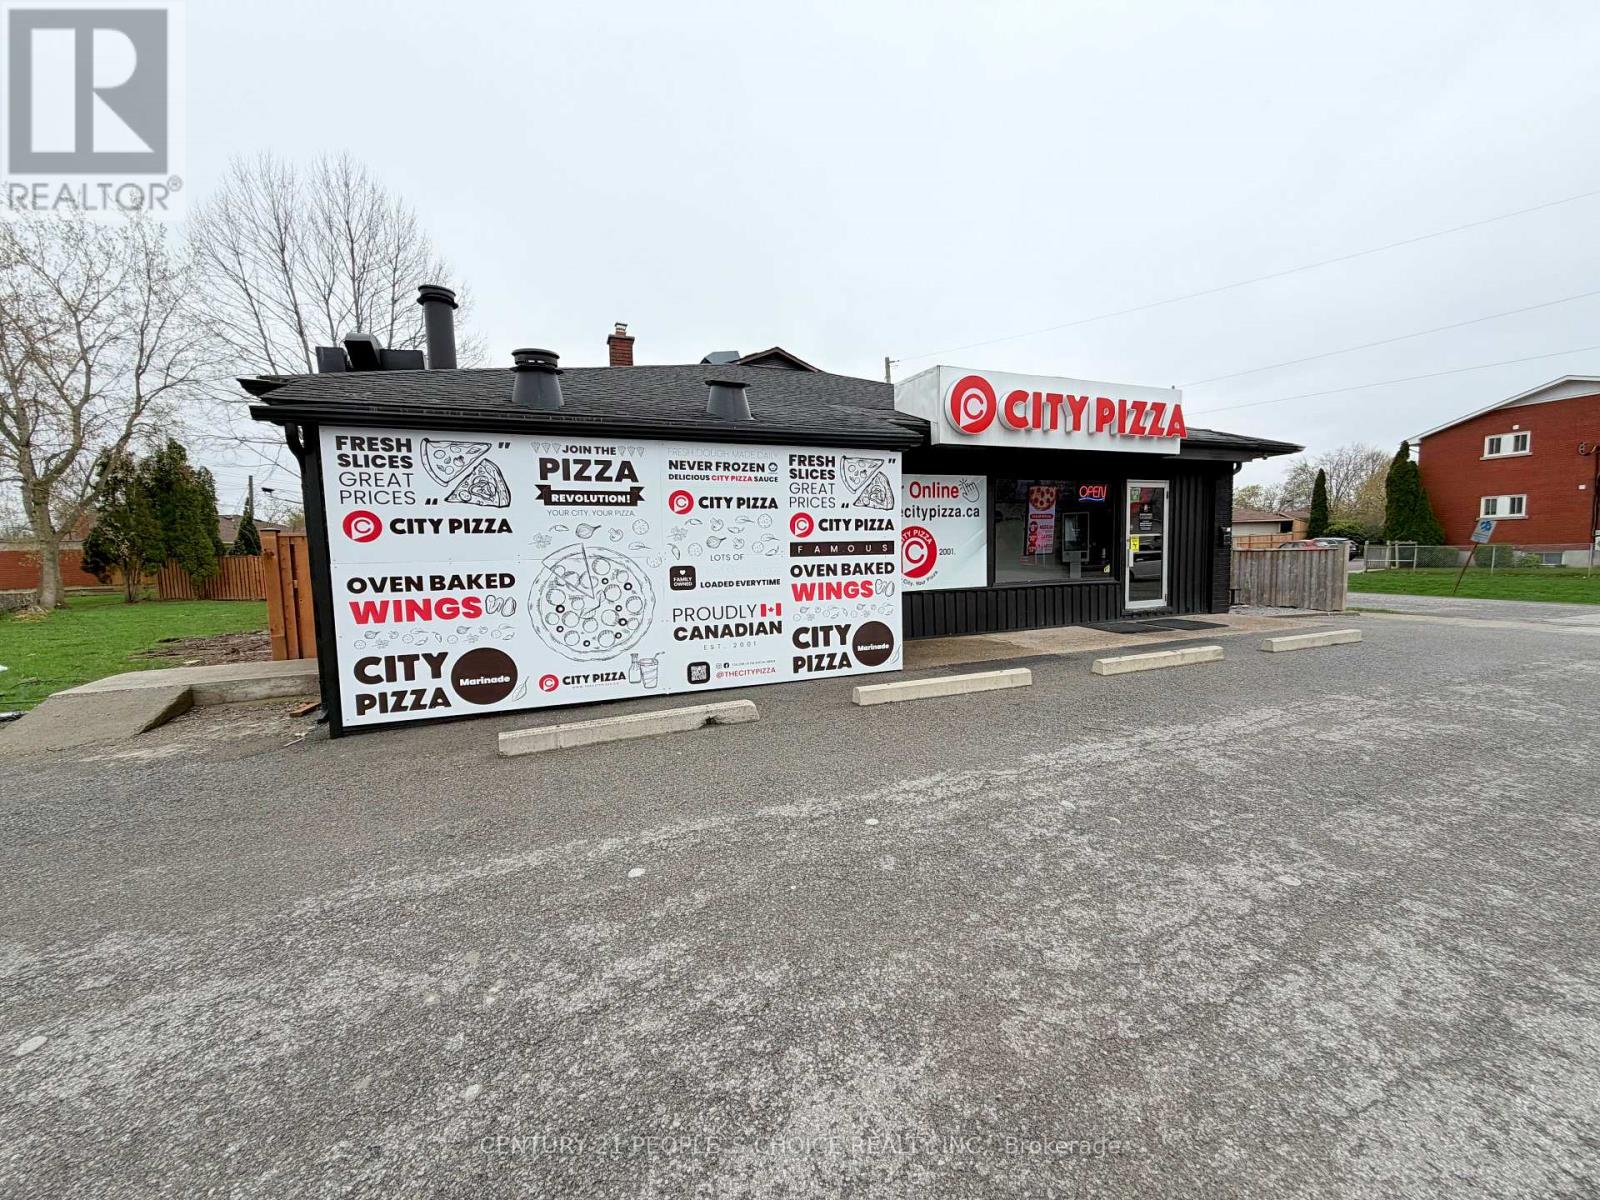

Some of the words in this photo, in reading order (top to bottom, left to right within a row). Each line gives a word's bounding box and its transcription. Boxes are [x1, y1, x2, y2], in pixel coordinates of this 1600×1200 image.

[1003, 389, 1089, 432] CITY
[1096, 397, 1188, 438] PIZZA
[335, 435, 412, 453] FRESH
[562, 445, 592, 454] JOIN
[593, 446, 617, 455] THE
[337, 453, 413, 469] SLICES
[668, 460, 713, 471] NEVER
[715, 462, 765, 473] FROZEN
[789, 454, 835, 467] FRESH
[539, 457, 639, 482] PIZZA
[789, 468, 835, 480] SLICES
[339, 471, 414, 488] GREAT
[789, 482, 836, 495] GREAT
[909, 481, 960, 499] Online
[1079, 485, 1107, 498] OPEN
[340, 490, 416, 505] PRICES
[551, 494, 631, 503] REVOLUTION!
[698, 496, 733, 509] CITY
[736, 497, 778, 509] PIZZA
[789, 497, 836, 508] PRICES
[546, 509, 569, 517] YOUR
[592, 509, 614, 517] YOUR
[901, 505, 980, 521] citypizza.ca
[389, 518, 443, 535] CITY
[450, 518, 513, 534] PIZZA
[818, 519, 852, 531] CITY
[855, 519, 894, 531] PIZZA
[913, 529, 933, 545] PIZZA
[797, 544, 888, 553] FAMOUS
[732, 553, 744, 561] OF
[790, 564, 838, 578] OVEN
[841, 562, 895, 576] BAKED
[346, 575, 424, 594] OVEN
[429, 573, 516, 592] BAKED
[700, 580, 734, 588] LOADED
[736, 579, 781, 587] EVERYTIME
[791, 580, 874, 602] WINGS
[349, 596, 483, 625] WINGS
[673, 604, 757, 622] PROUDLY
[673, 621, 782, 641] CANADIAN
[792, 624, 851, 650] CITY
[353, 652, 448, 685] CITY
[793, 652, 852, 674] PIZZA
[459, 675, 511, 687] Marinade
[562, 674, 590, 685] CITY
[592, 671, 626, 683] PIZZA
[355, 687, 452, 716] PIZZA
